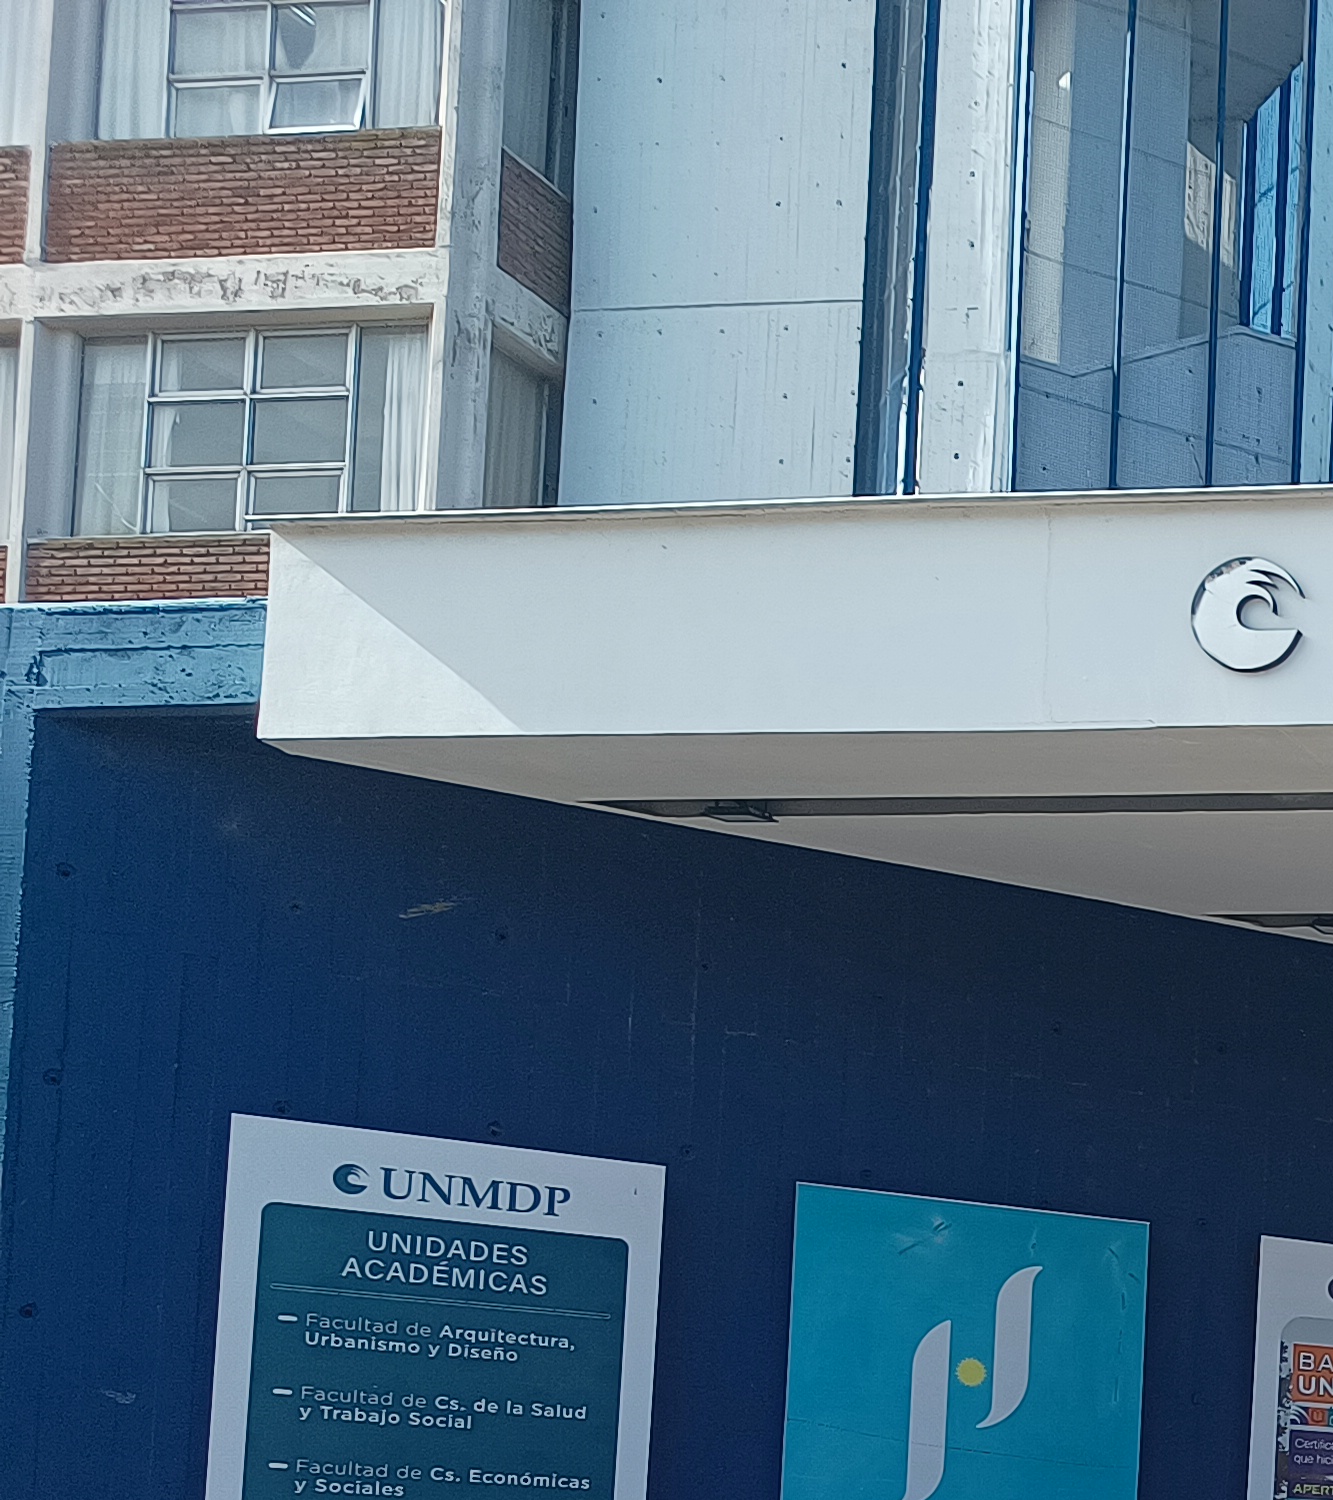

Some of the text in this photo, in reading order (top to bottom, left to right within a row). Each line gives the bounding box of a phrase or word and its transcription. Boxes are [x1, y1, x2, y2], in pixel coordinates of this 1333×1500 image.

[380, 1166, 571, 1217] UNMDP
[368, 1230, 528, 1265] UNIDADES
[341, 1257, 548, 1296] ACADÉMICAS
[305, 1313, 575, 1351] Facultad de Arquitectura,
[305, 1331, 519, 1361] Urbanismo y Diseño
[299, 1405, 472, 1430] y Trabajo Social
[301, 1386, 587, 1420] Facultad de Cs. de la Salud
[295, 1459, 591, 1490] Facultad de Cs. Económicas
[1293, 1455, 1315, 1465] que
[293, 1479, 405, 1497] y Sociales
